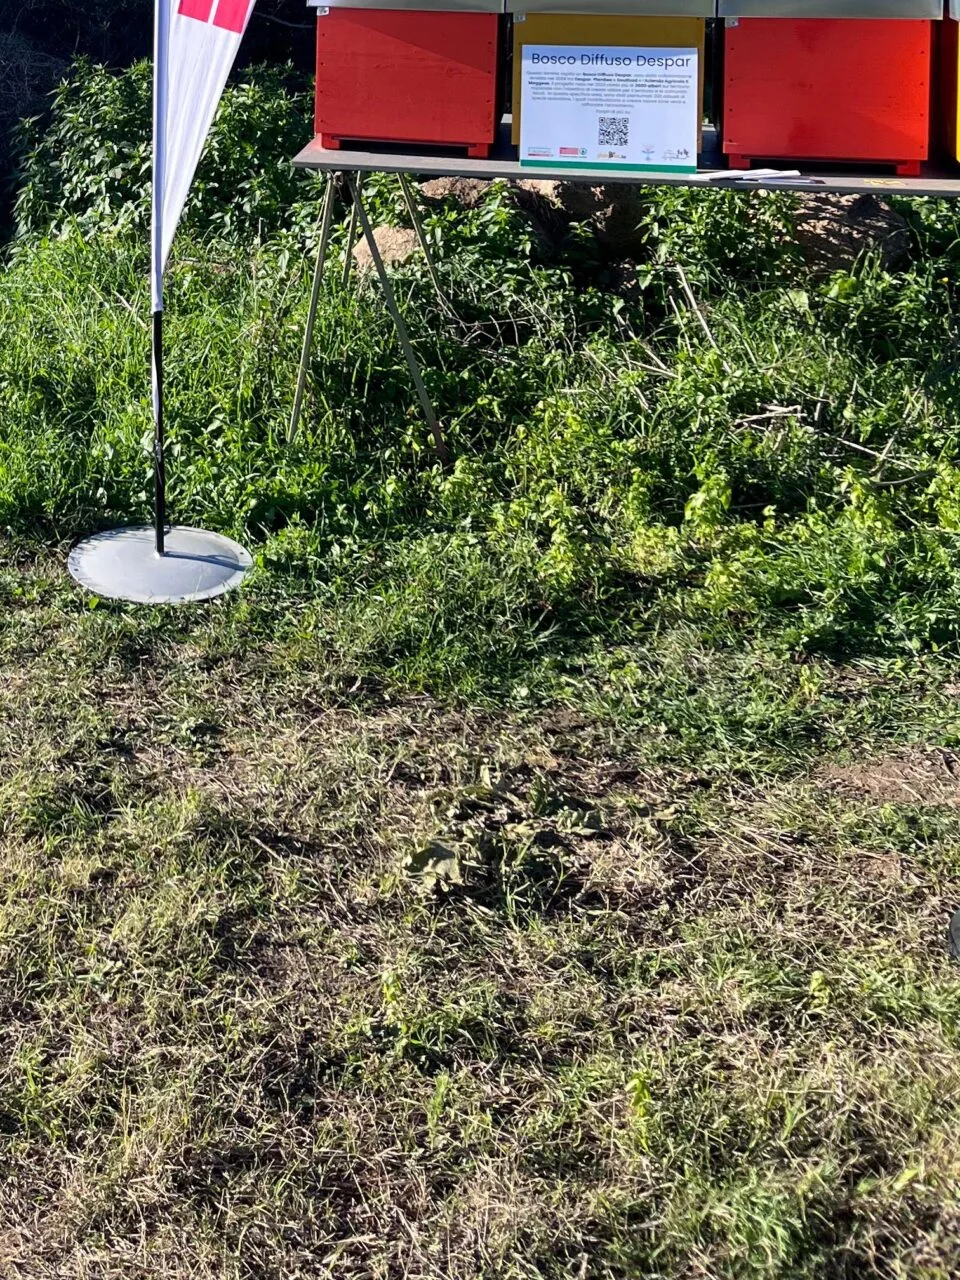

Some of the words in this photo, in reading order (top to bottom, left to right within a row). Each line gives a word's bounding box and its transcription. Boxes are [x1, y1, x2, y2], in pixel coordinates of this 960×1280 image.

[531, 52, 577, 65] Bosco
[580, 53, 632, 66] Diffuso
[636, 55, 692, 70] Despar
